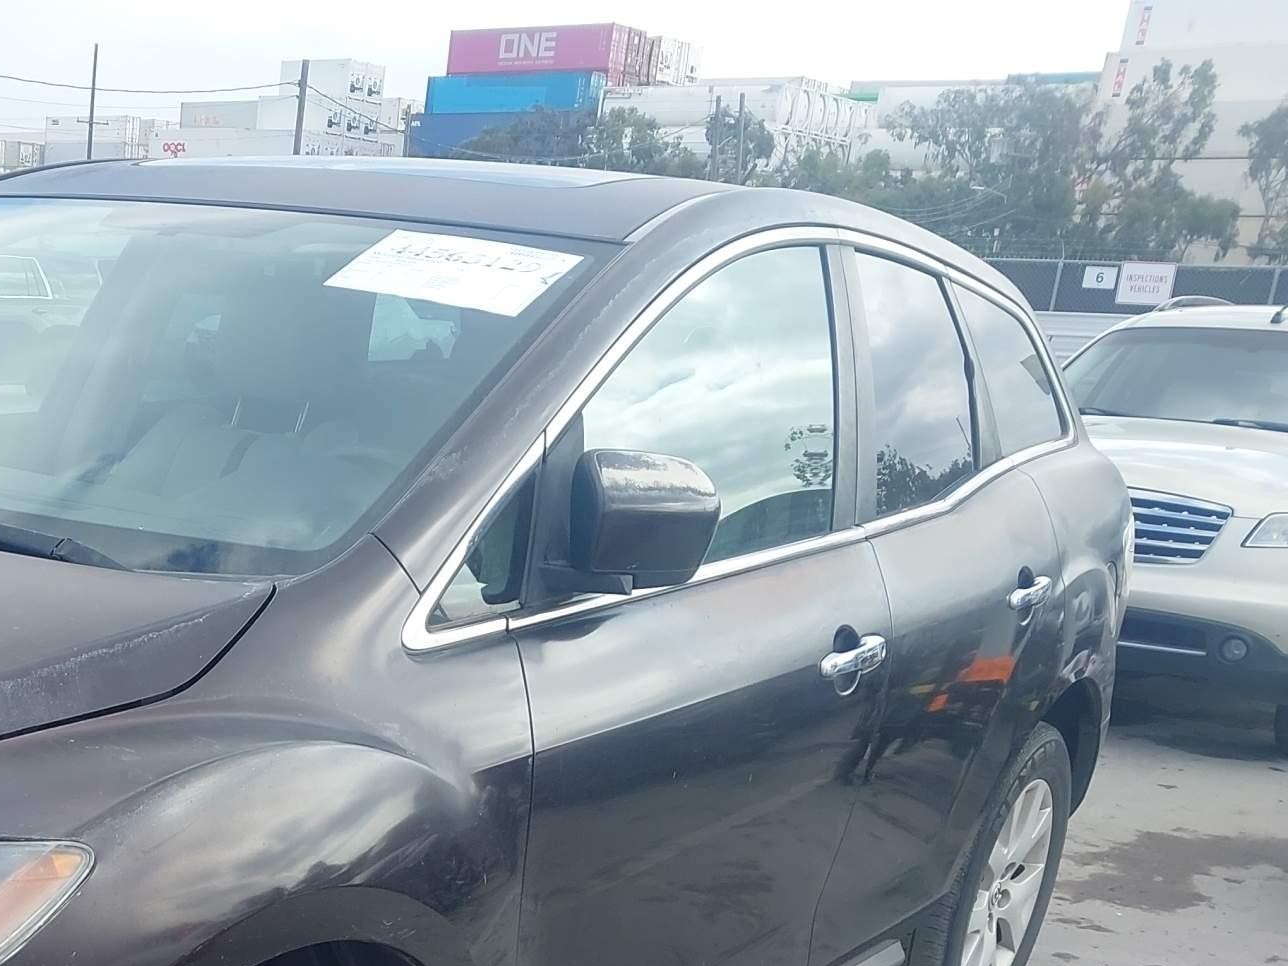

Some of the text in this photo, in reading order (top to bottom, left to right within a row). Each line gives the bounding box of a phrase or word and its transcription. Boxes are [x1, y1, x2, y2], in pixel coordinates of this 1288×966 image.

[499, 31, 557, 59] ONE
[163, 142, 186, 153] OOCL
[1095, 272, 1105, 283] 6
[1129, 284, 1160, 294] VEHICLES
